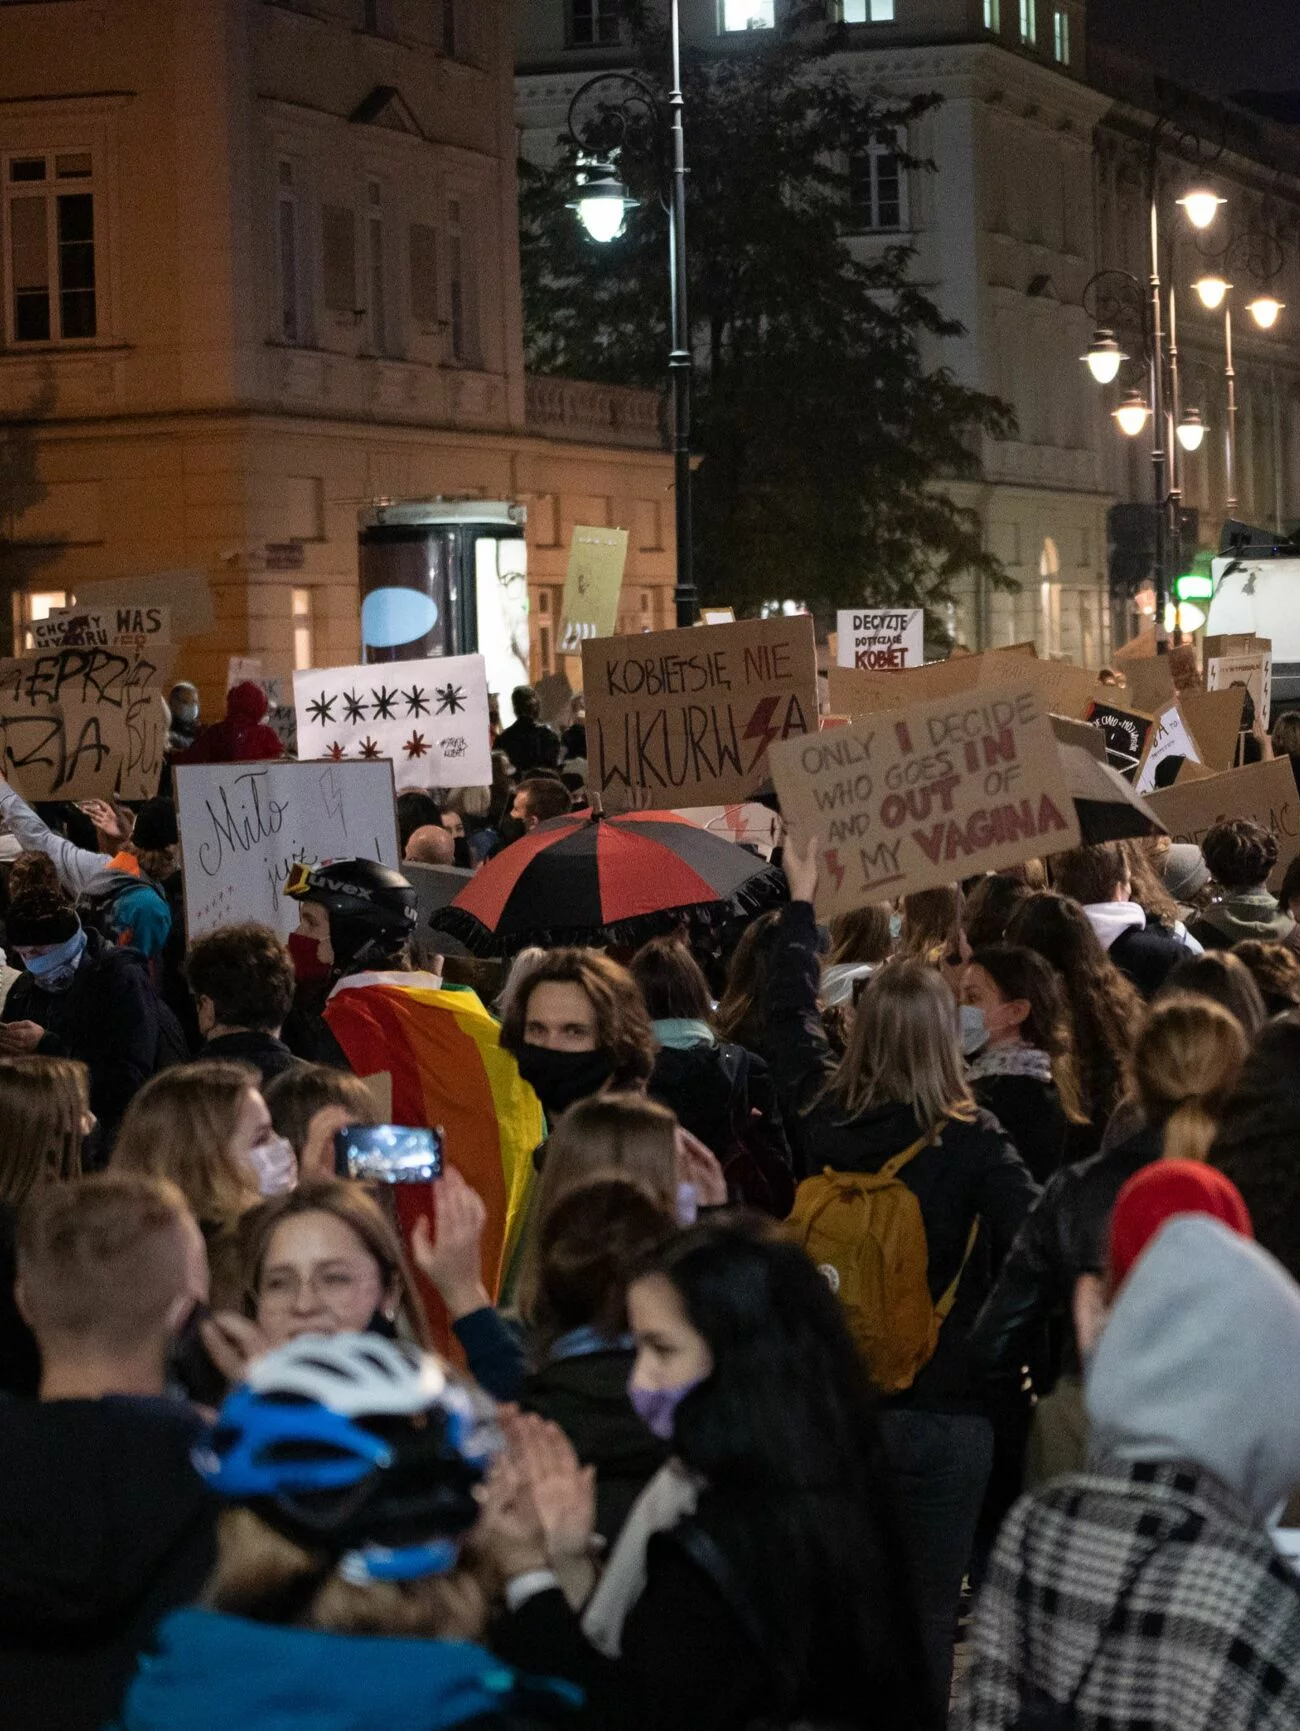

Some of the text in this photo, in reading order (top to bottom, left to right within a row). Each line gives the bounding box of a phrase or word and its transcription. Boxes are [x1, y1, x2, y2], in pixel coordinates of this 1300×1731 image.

[853, 613, 909, 631] DECYZJE
[689, 651, 732, 692] SIĘ
[743, 642, 794, 685] NIE
[855, 647, 908, 671] KOBIET
[801, 692, 1038, 775] ONLY I DECIDE
[812, 728, 1016, 811] WHO GOES IN
[827, 764, 1021, 843] AND OUT OF
[859, 793, 1069, 880] MY VAGINA
[309, 875, 374, 901] uvex
